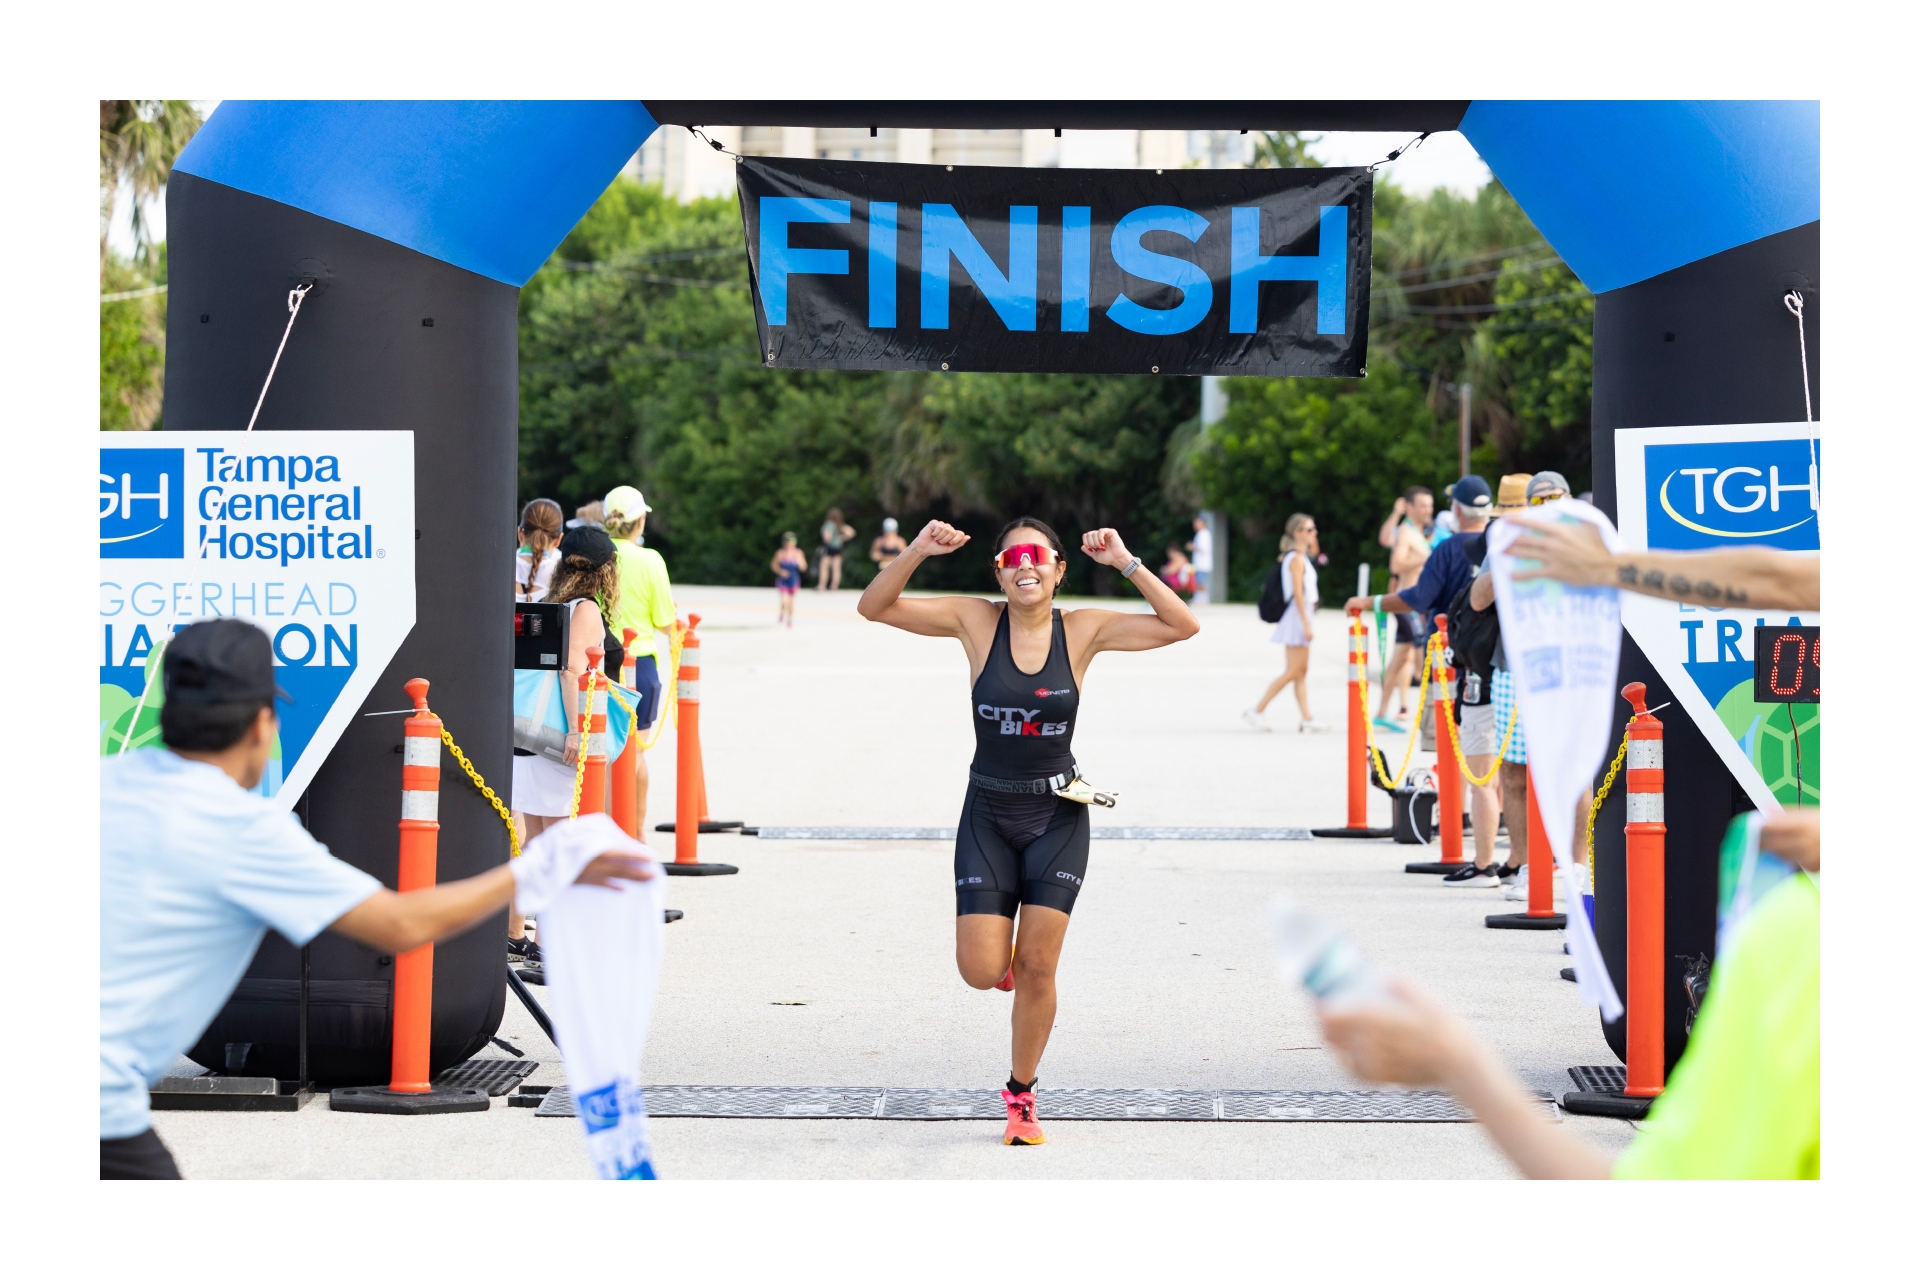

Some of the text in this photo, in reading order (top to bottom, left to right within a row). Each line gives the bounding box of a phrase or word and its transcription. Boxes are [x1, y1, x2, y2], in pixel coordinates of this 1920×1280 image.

[759, 196, 1348, 335] FINISH
[197, 447, 341, 489] Tampa
[198, 486, 361, 521] General
[1680, 465, 1818, 514] TGH
[978, 704, 1041, 722] CITY
[1000, 720, 1068, 736] BIKES
[1056, 871, 1077, 882] CITY
